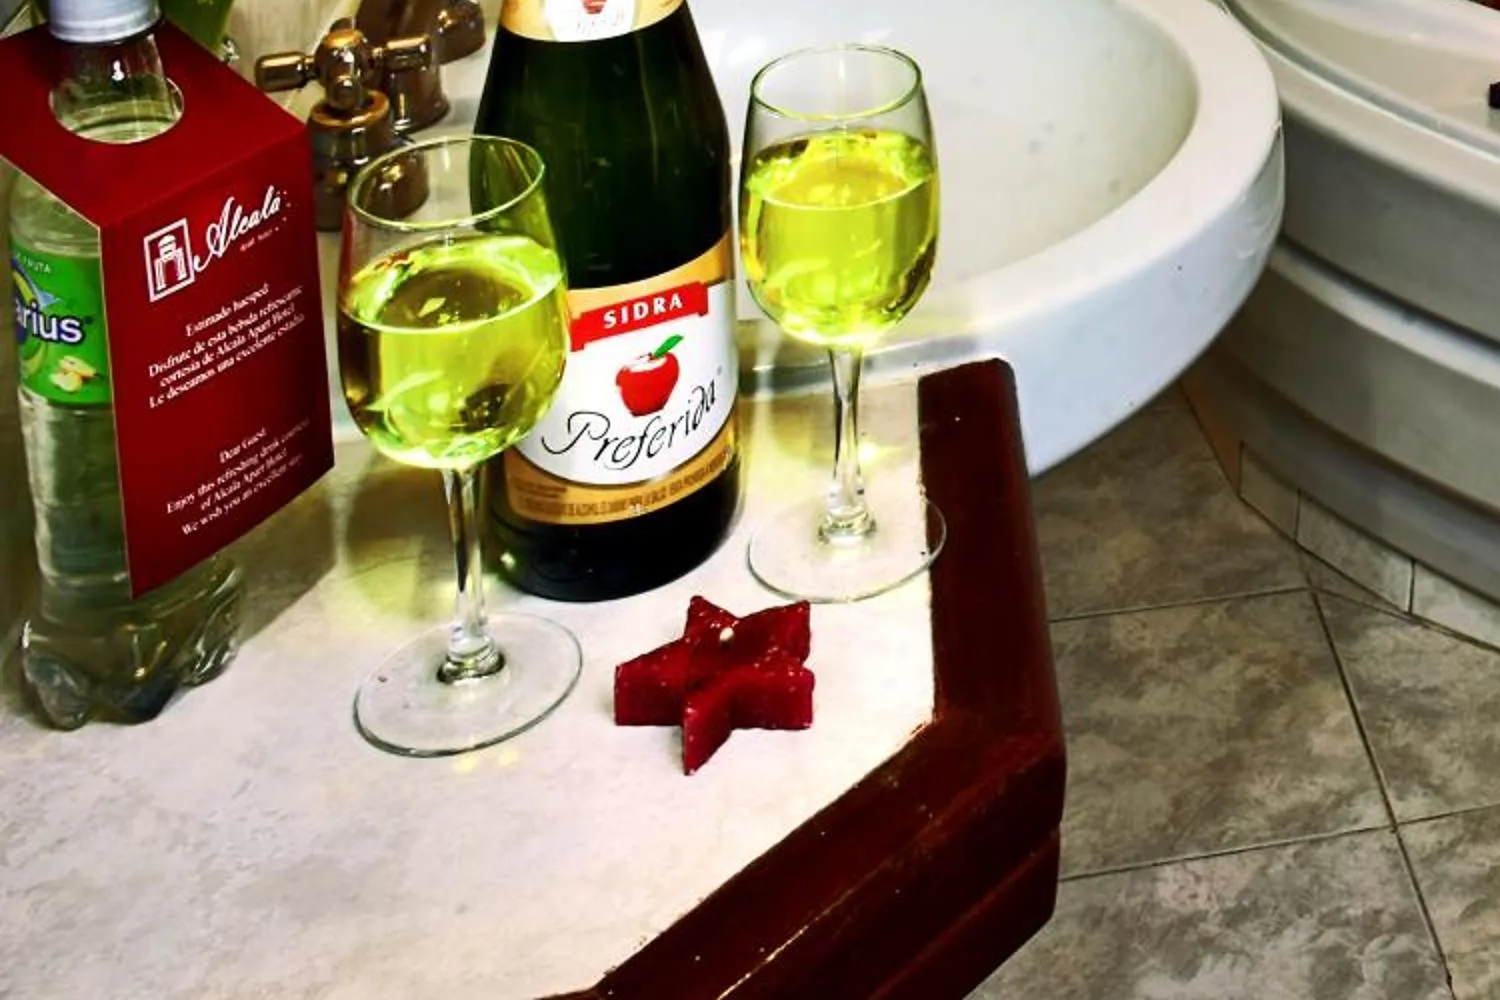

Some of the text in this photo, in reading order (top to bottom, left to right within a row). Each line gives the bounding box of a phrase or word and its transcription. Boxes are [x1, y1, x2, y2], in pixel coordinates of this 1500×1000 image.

[185, 306, 232, 337] Estimado
[603, 293, 684, 328] SIDRA
[202, 351, 215, 366] de
[248, 319, 271, 344] Apart
[271, 302, 295, 325] Hotel
[148, 349, 191, 377] Disfrute
[193, 341, 206, 356] de
[207, 331, 227, 347] esta
[149, 395, 165, 409] Le
[166, 369, 216, 400] deseamos
[217, 356, 235, 373] una
[541, 379, 717, 471] Preferida
[219, 445, 241, 464] Dear
[166, 493, 195, 514] Enjoy
[197, 481, 216, 497] this
[200, 495, 212, 511] of
[181, 521, 200, 535] We
